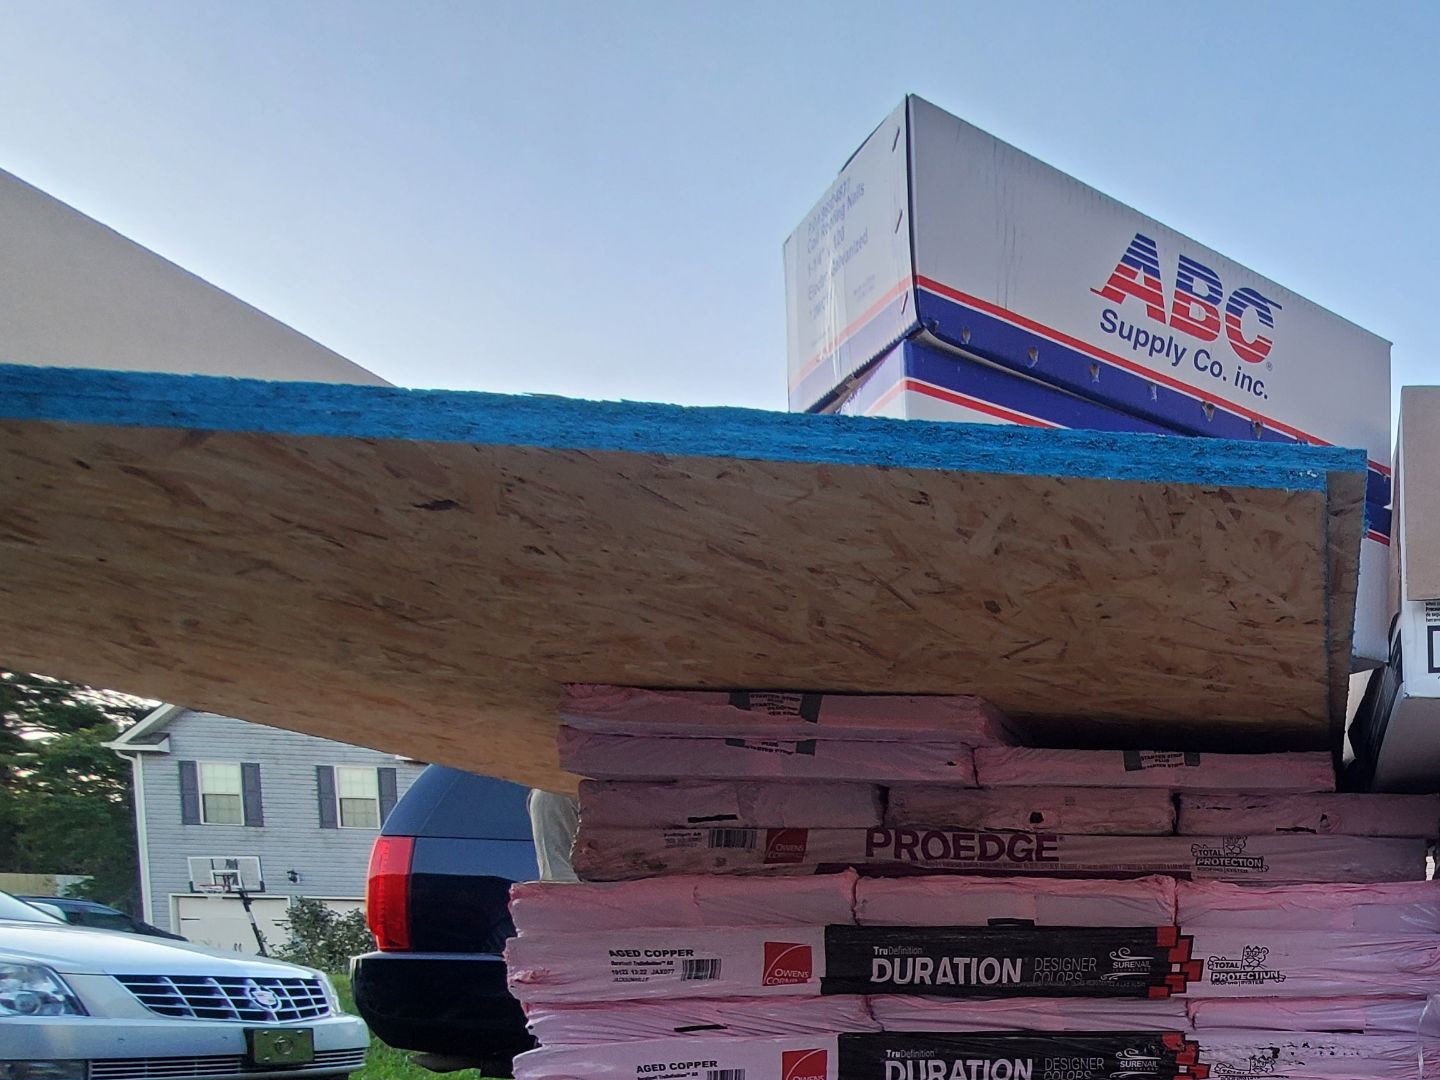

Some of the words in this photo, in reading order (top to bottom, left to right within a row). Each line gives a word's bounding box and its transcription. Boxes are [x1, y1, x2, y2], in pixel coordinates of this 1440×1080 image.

[1089, 233, 1282, 364] ABC
[1100, 308, 1187, 367] Supply
[1193, 349, 1226, 381] Co.
[1234, 366, 1268, 399] inc.
[865, 826, 1060, 863] PROEDGE
[1197, 858, 1262, 867] PROTECTION
[608, 950, 641, 958] AGED
[644, 949, 694, 958] COPPER
[870, 957, 1022, 985] DURATION
[1033, 957, 1097, 972] DESIGNER
[1112, 960, 1151, 969] SURENAIL
[1214, 961, 1240, 969] TOTAL
[774, 969, 809, 978] OWENS
[636, 1064, 667, 1073] AGED
[669, 1060, 718, 1070] COPPER
[1044, 1057, 1105, 1071] DESIGNER
